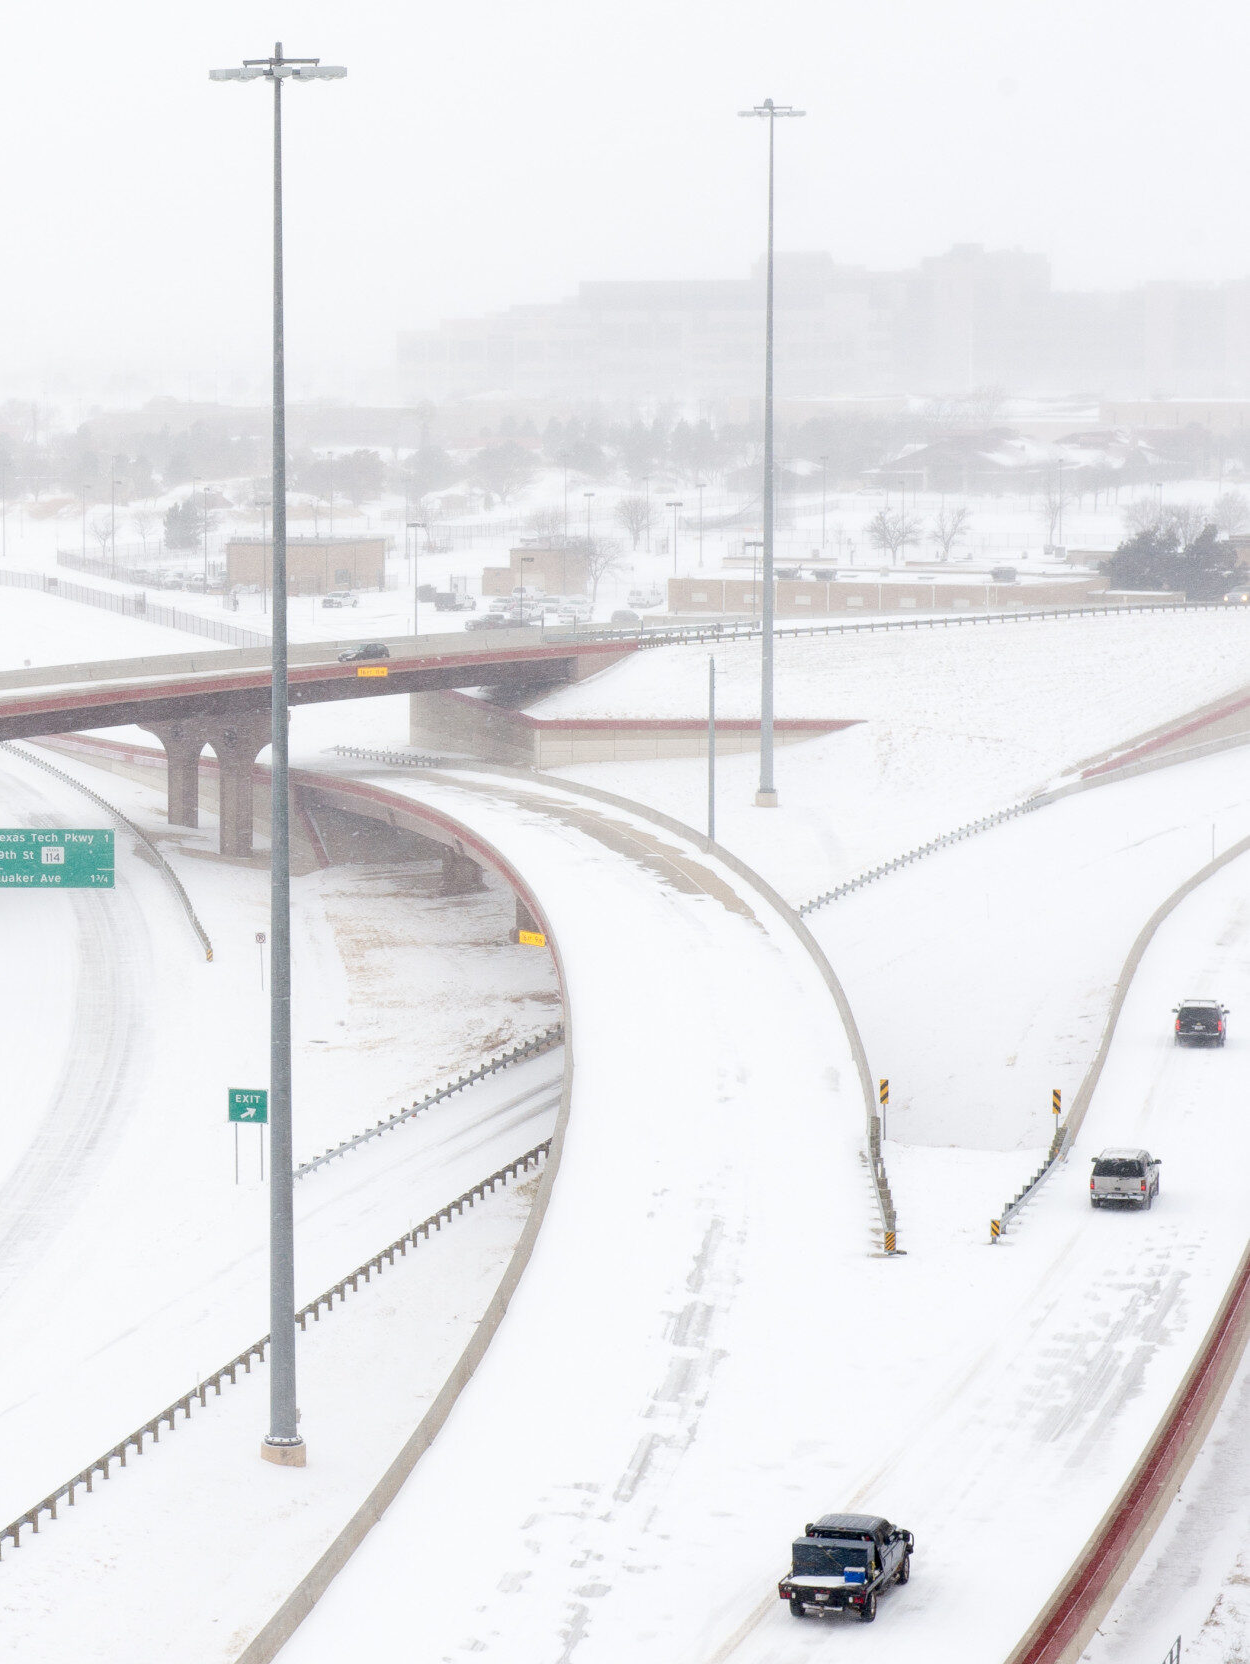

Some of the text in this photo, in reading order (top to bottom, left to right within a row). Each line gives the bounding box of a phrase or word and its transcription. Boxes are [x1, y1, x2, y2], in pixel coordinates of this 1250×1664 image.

[31, 833, 58, 842] Tech
[64, 833, 94, 844] Pkwy
[104, 834, 109, 842] 1
[22, 851, 34, 860] St
[46, 853, 60, 863] 114
[40, 873, 62, 883] Ave
[235, 1094, 261, 1104] EXIT
